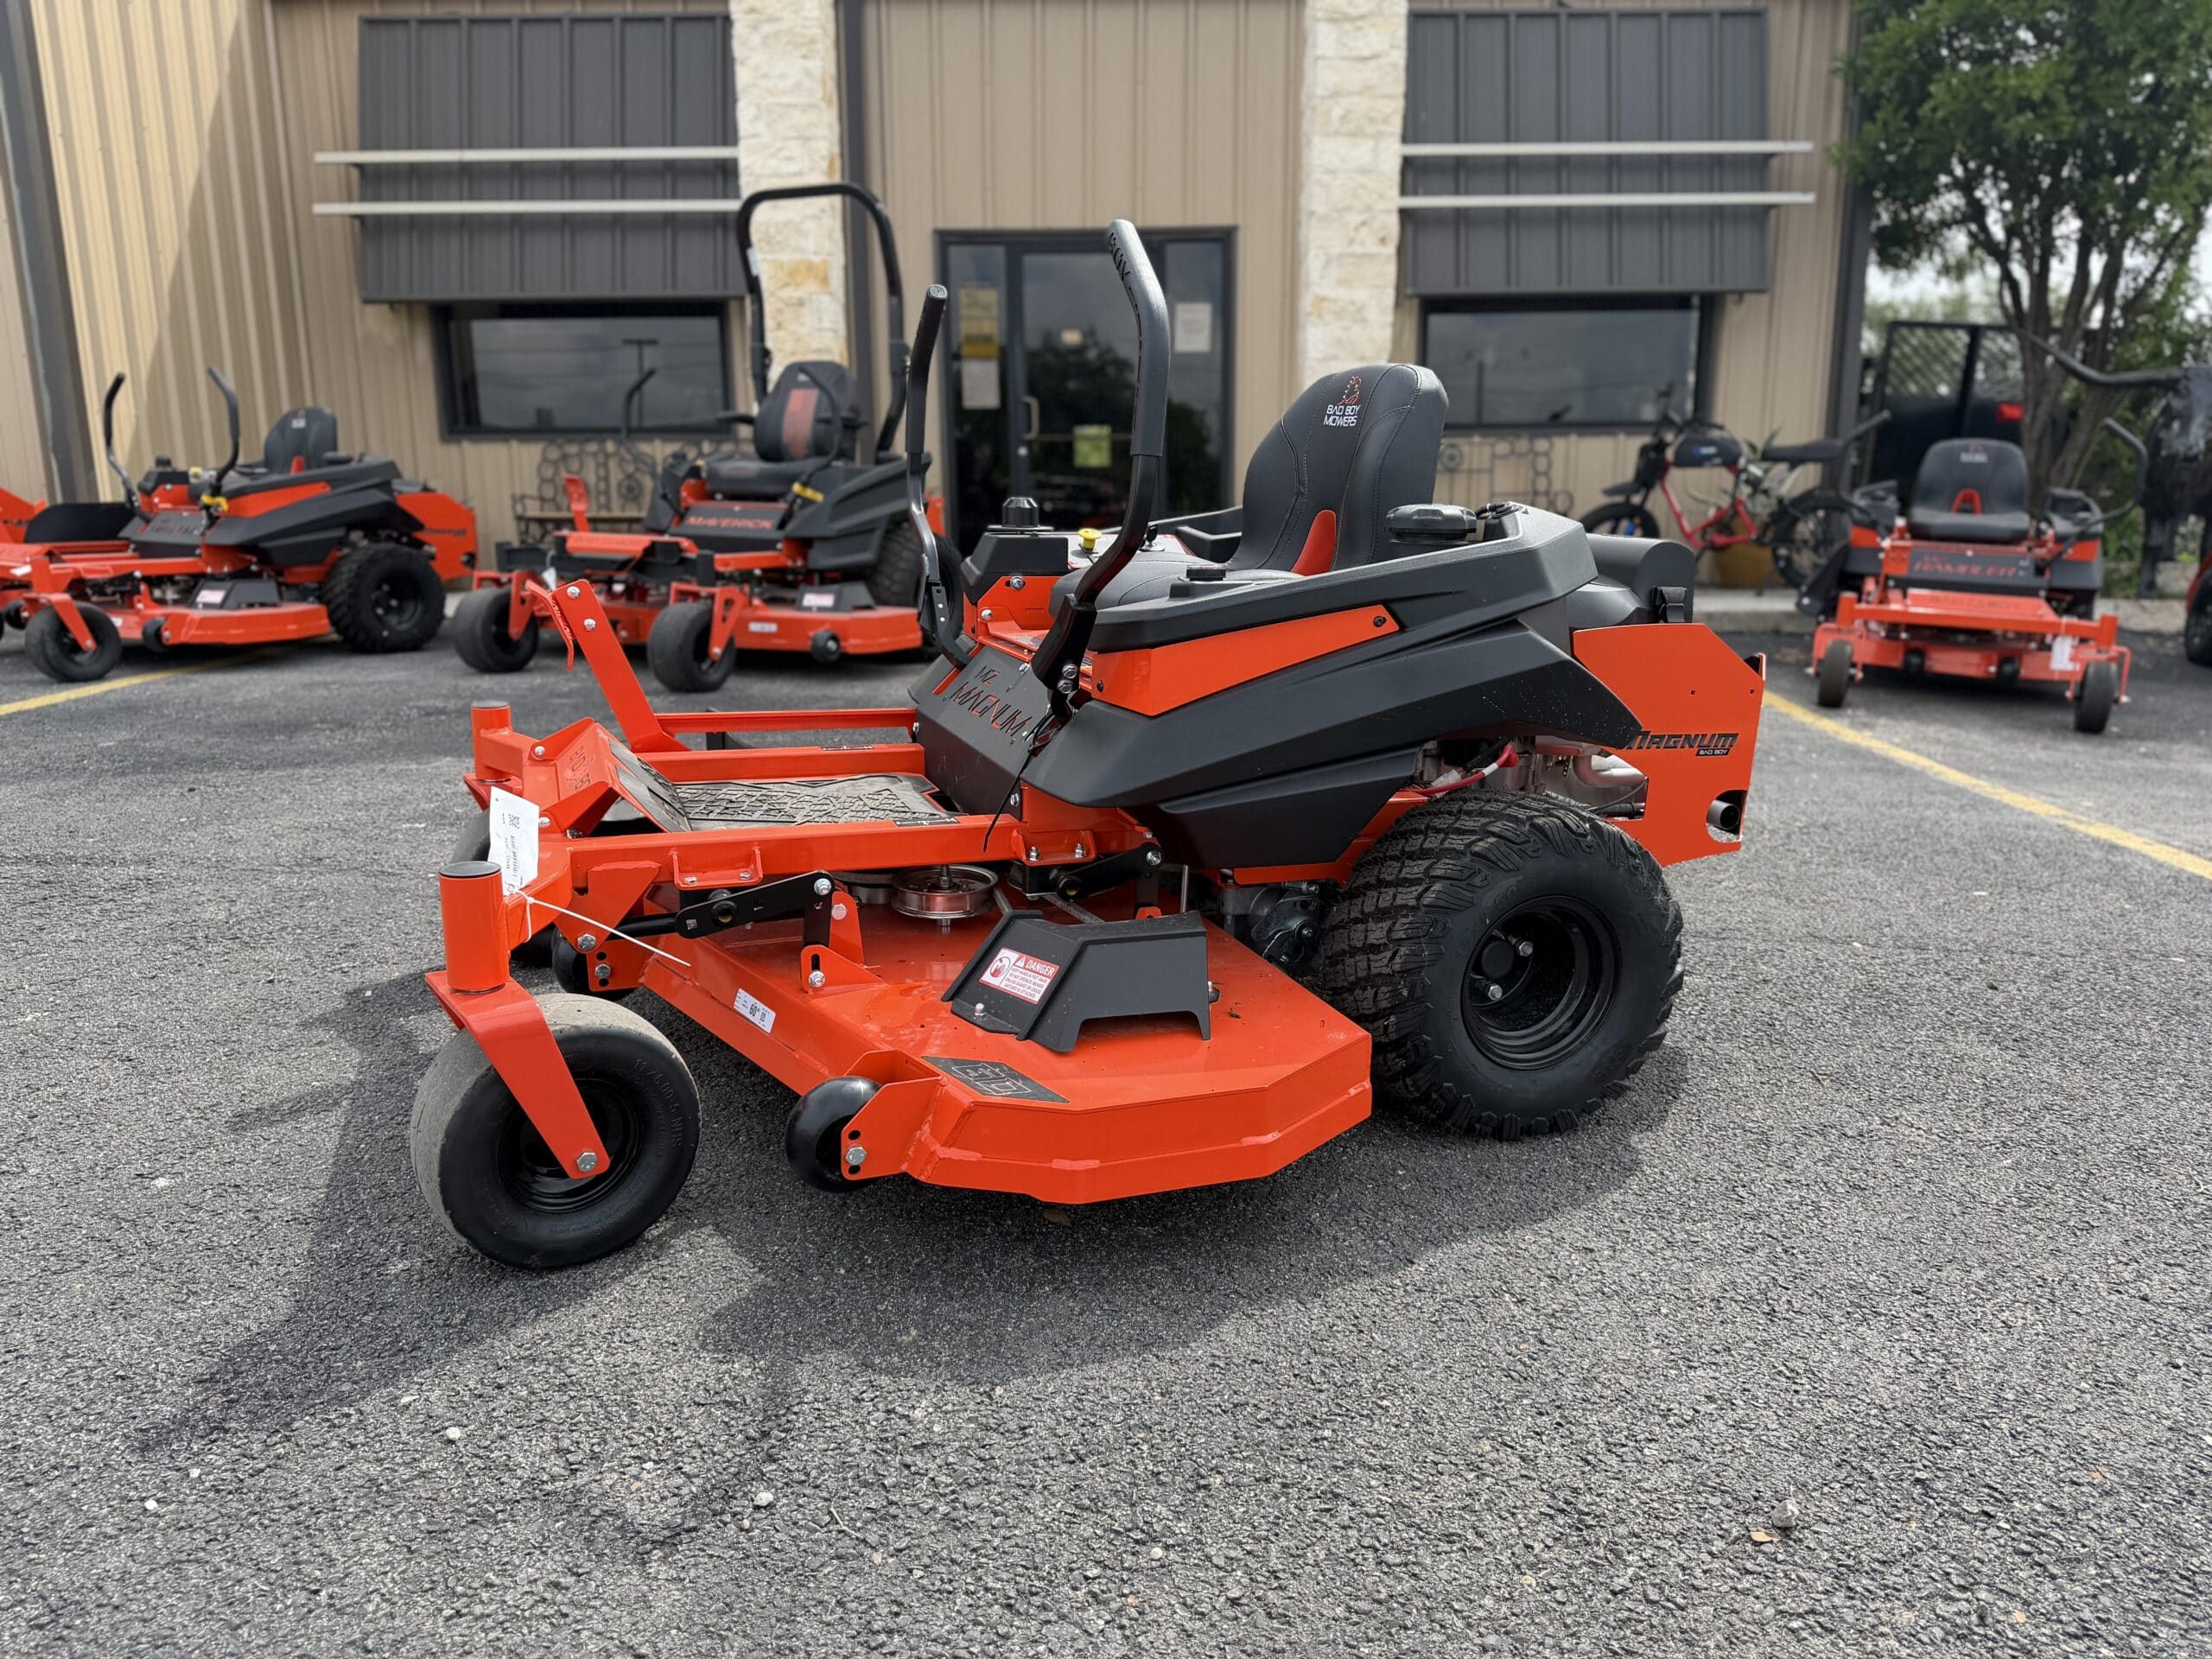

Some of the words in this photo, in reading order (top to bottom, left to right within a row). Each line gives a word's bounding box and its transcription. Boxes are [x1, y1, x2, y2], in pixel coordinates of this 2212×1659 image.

[1327, 405, 1344, 415] BAD
[1344, 404, 1361, 416] BOY
[1323, 416, 1358, 427] MOWERS
[975, 665, 1000, 686] MZ
[949, 681, 1033, 737] MAGNUM
[1626, 730, 1738, 749] MAGNUM
[1026, 960, 1055, 976] DANGER
